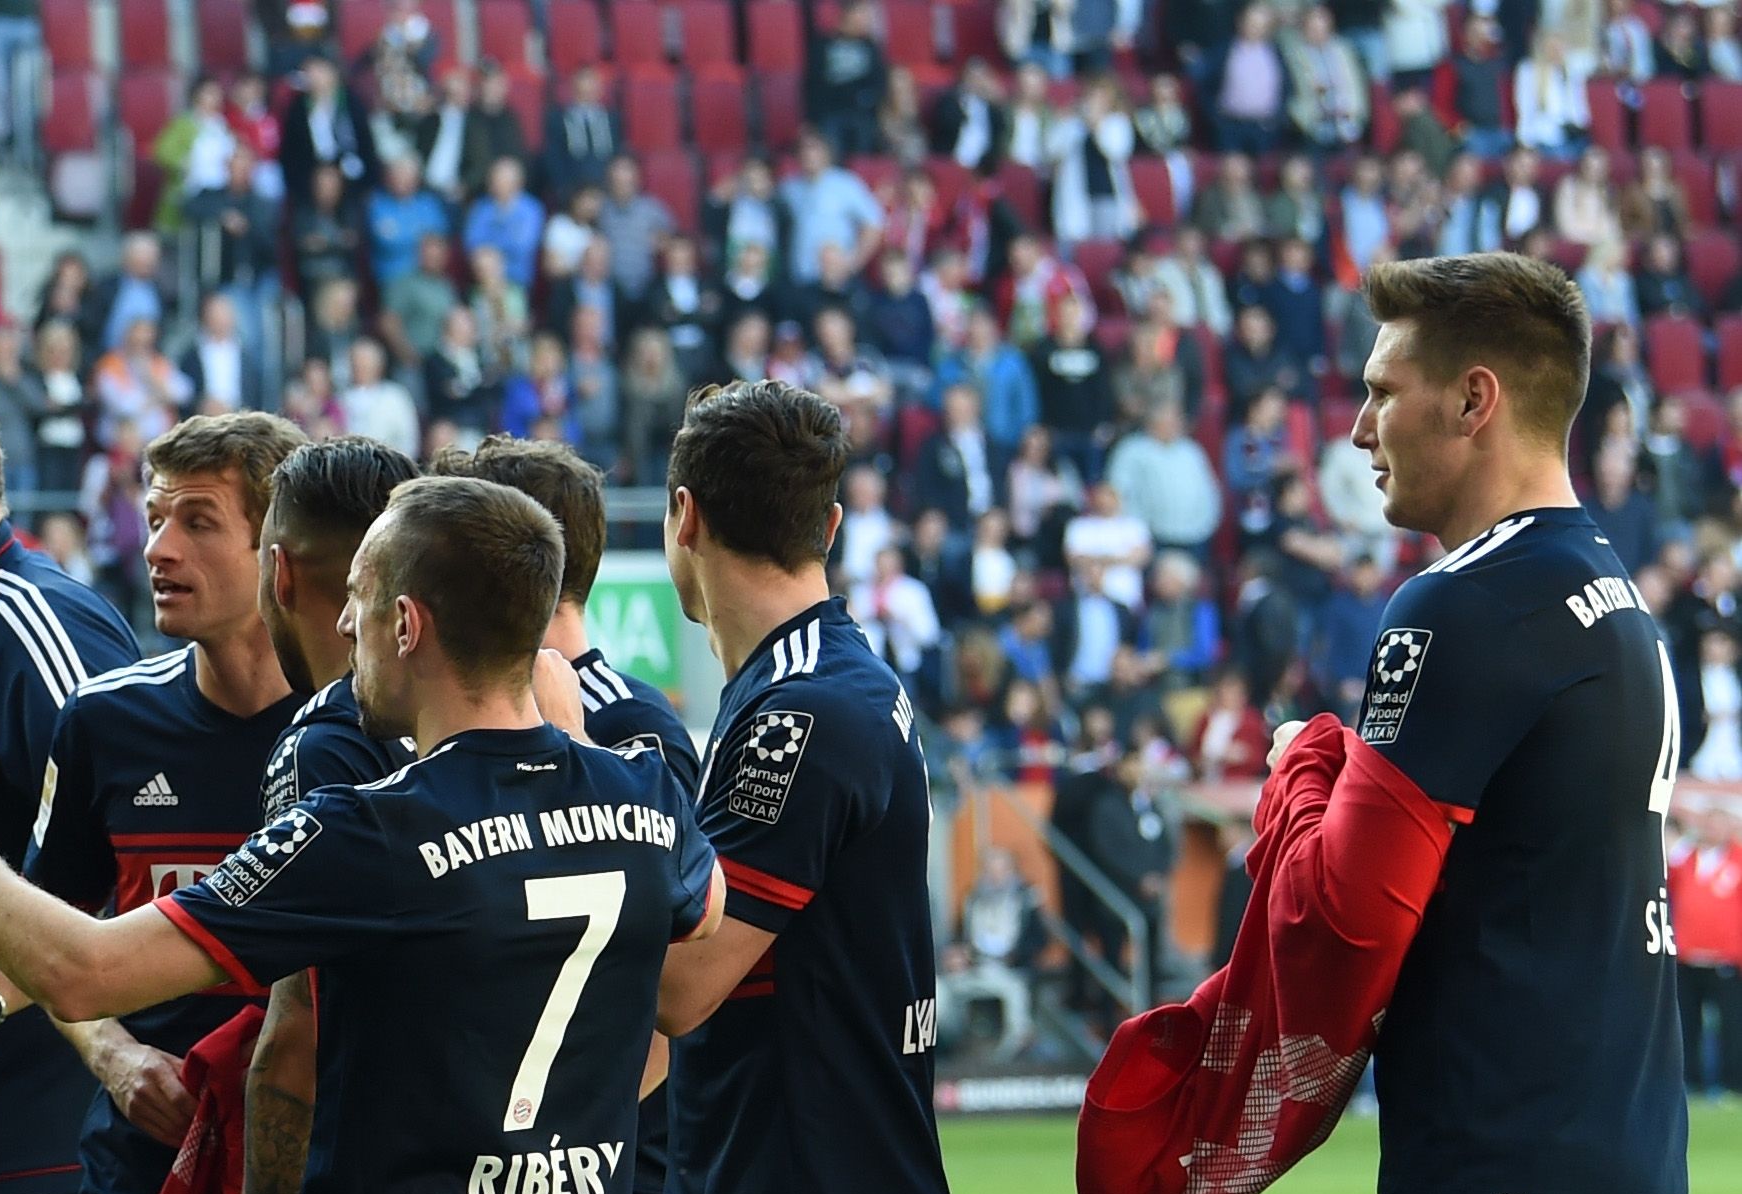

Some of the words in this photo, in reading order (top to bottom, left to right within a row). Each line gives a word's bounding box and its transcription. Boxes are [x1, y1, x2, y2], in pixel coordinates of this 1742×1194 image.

[741, 763, 791, 785] Hamad
[133, 792, 179, 806] adidas
[737, 778, 784, 801] Airport
[732, 796, 778, 820] QATAR
[418, 813, 533, 880] BAYERN
[539, 803, 676, 851] MÜNCHEN
[503, 870, 627, 1132] 7
